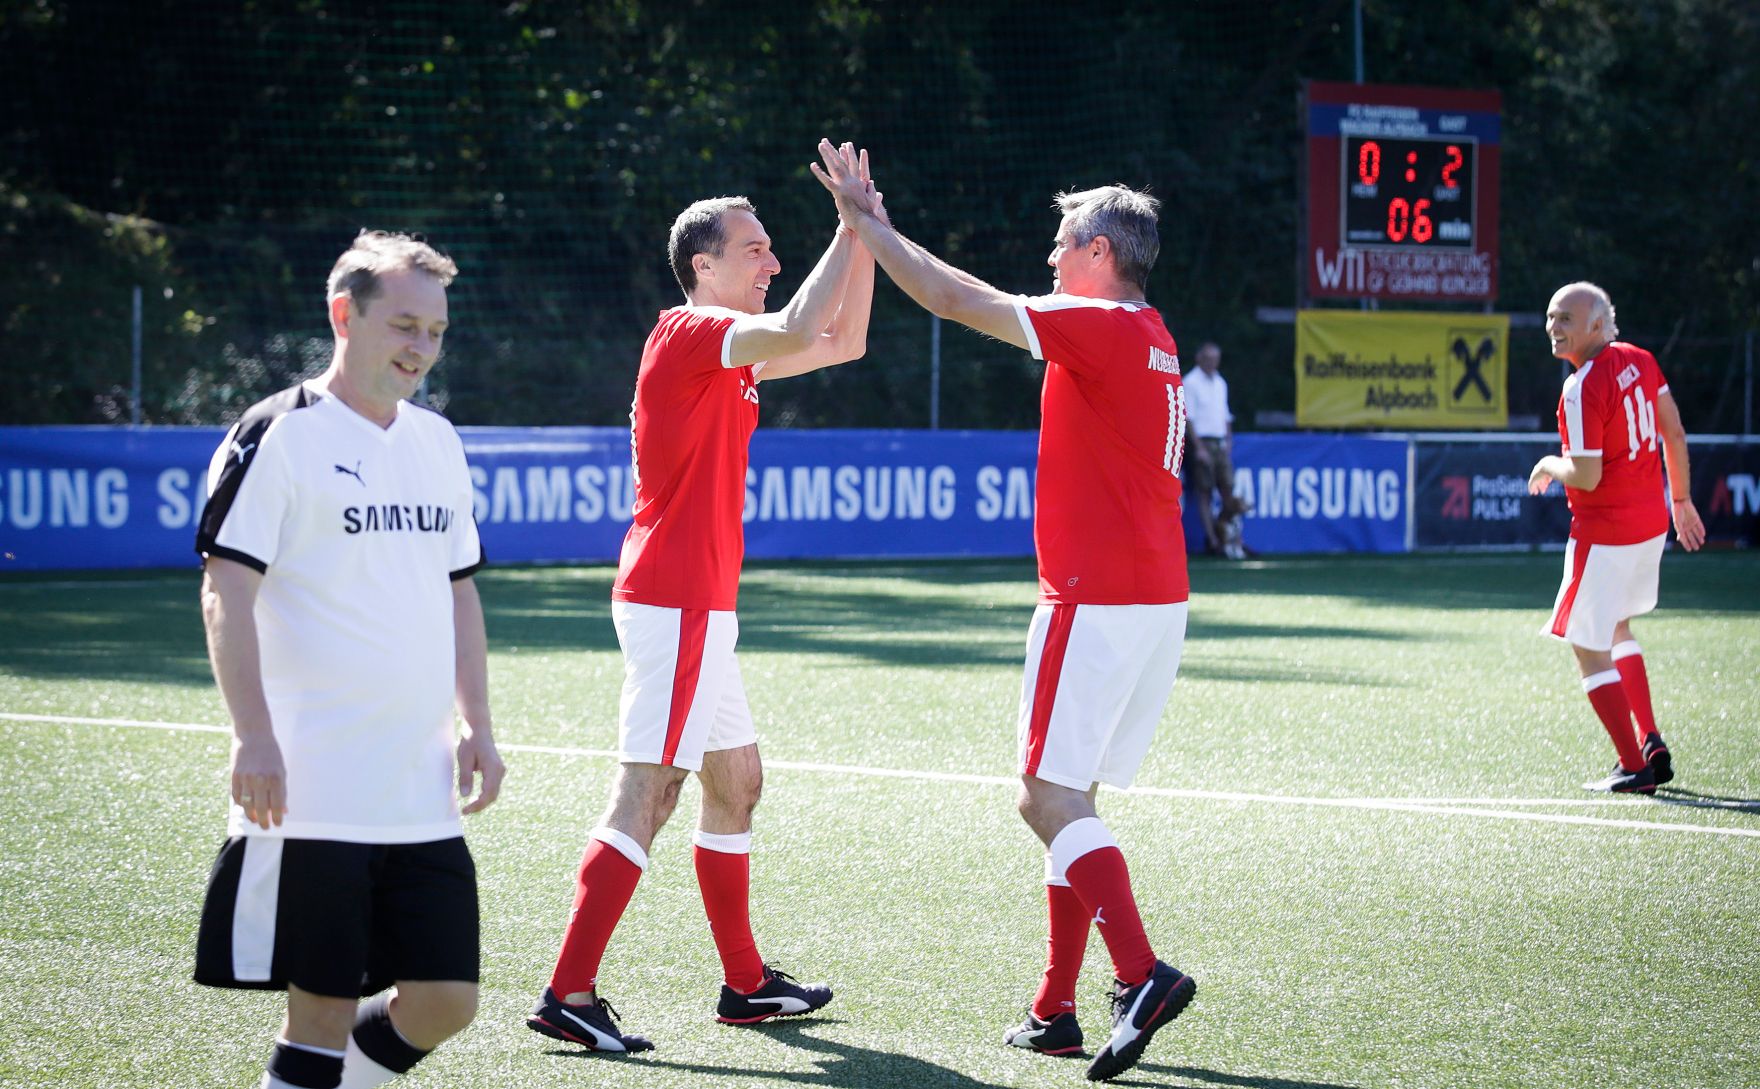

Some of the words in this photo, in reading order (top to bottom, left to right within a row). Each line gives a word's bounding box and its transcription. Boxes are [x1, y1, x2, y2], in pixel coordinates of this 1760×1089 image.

[1359, 141, 1381, 186] 0
[1441, 145, 1464, 189] 2
[1387, 197, 1433, 244] 06
[1439, 217, 1472, 241] min
[1304, 352, 1438, 380] Raiffeisenbank
[1364, 384, 1438, 415] Alpbach
[1623, 385, 1657, 461] 14
[0, 467, 129, 529] UNG
[1233, 466, 1399, 520] AMSUNG
[344, 505, 454, 534] SAMUN
